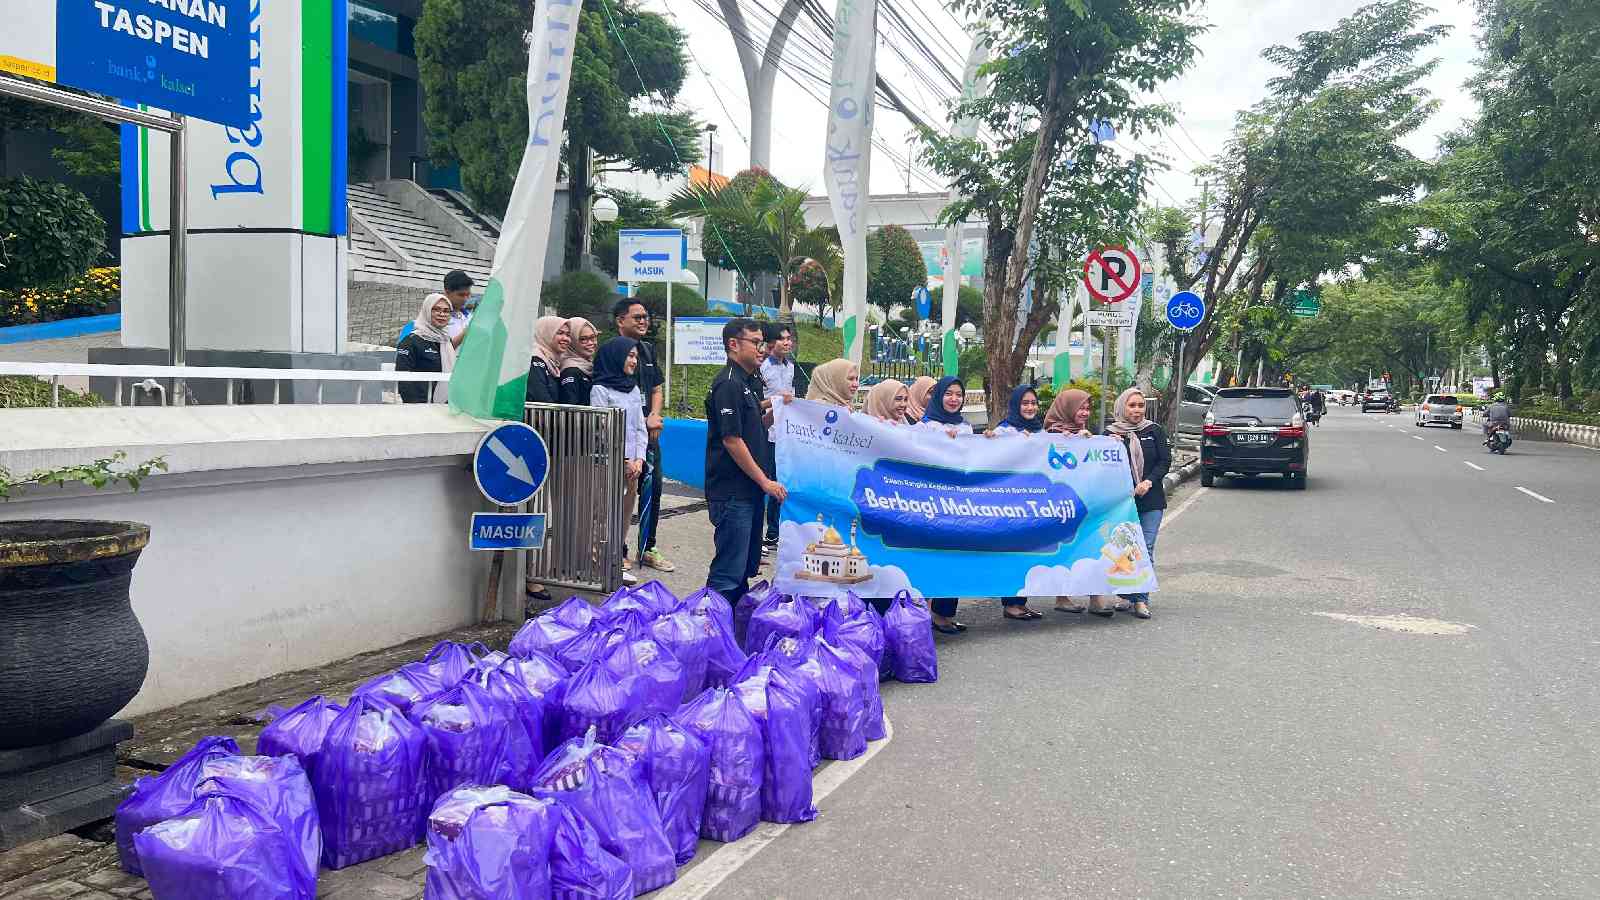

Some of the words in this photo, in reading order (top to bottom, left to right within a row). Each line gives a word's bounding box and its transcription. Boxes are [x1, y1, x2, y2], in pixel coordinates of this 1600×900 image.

[149, 0, 226, 28] NAN
[95, 1, 209, 58] TASPEN
[634, 266, 664, 275] MASUK
[1101, 256, 1126, 290] P
[785, 419, 816, 439] bank
[832, 430, 874, 448] kalsel
[1083, 448, 1123, 462] AKSEL
[904, 479, 928, 489] Rangka
[864, 487, 938, 519] Berbagi
[940, 496, 1026, 518] Makanan
[1026, 500, 1076, 523] Takjil
[480, 526, 536, 539] MASUK
